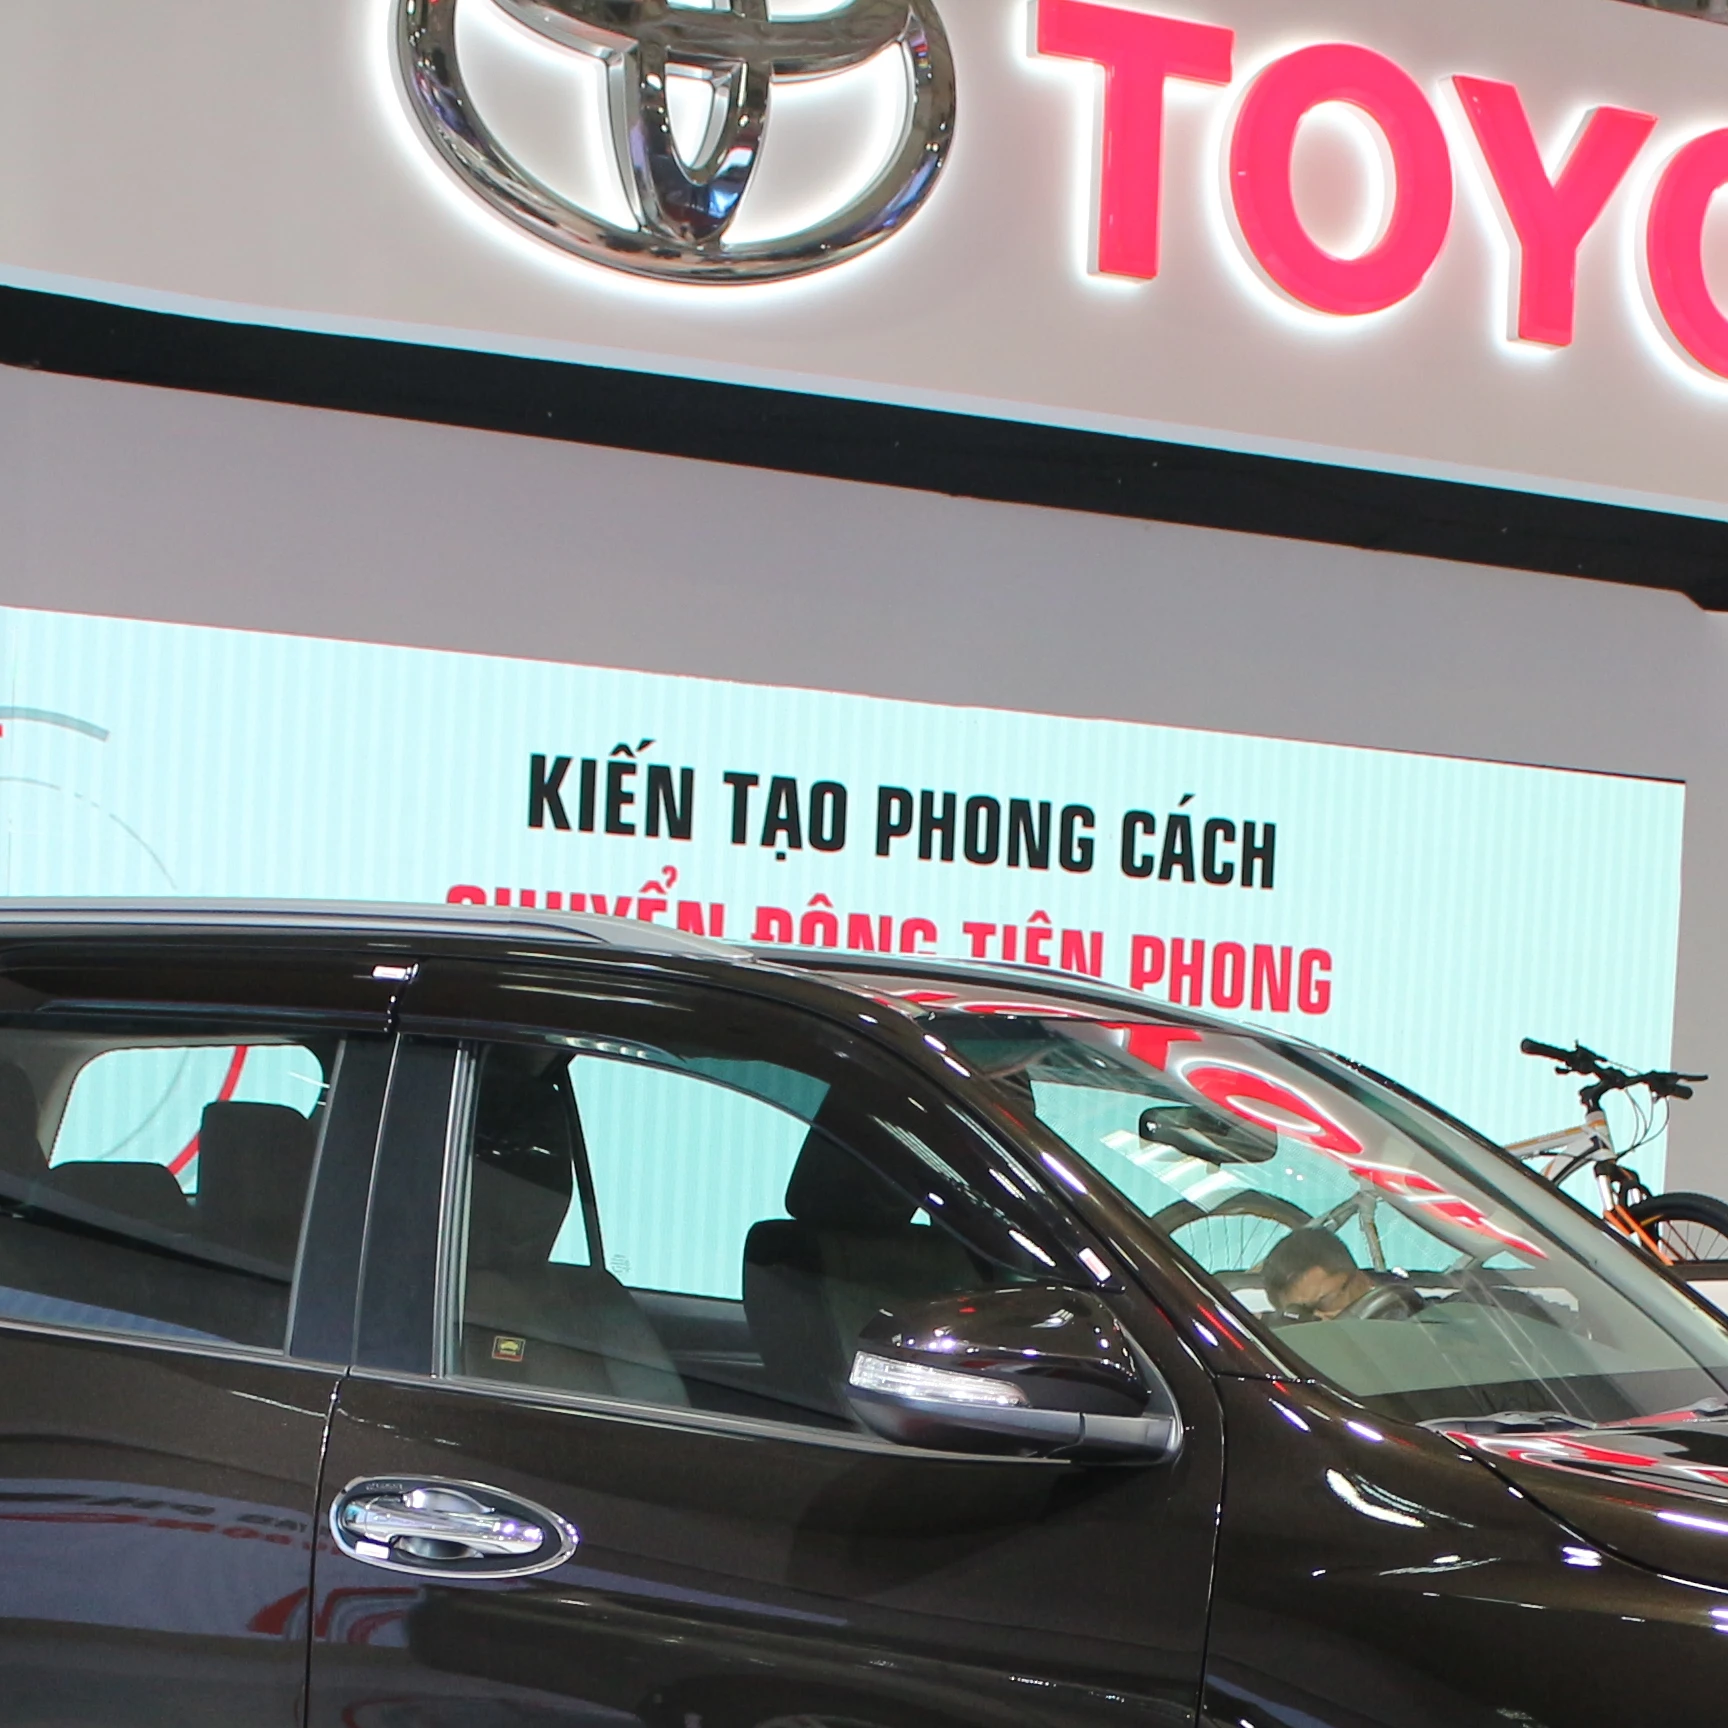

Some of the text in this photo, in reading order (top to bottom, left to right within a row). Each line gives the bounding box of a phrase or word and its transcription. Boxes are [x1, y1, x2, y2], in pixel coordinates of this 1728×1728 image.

[528, 739, 1277, 889] KIẾN TẠO PHONG CÁCH
[1130, 933, 1334, 1015] PHONG
